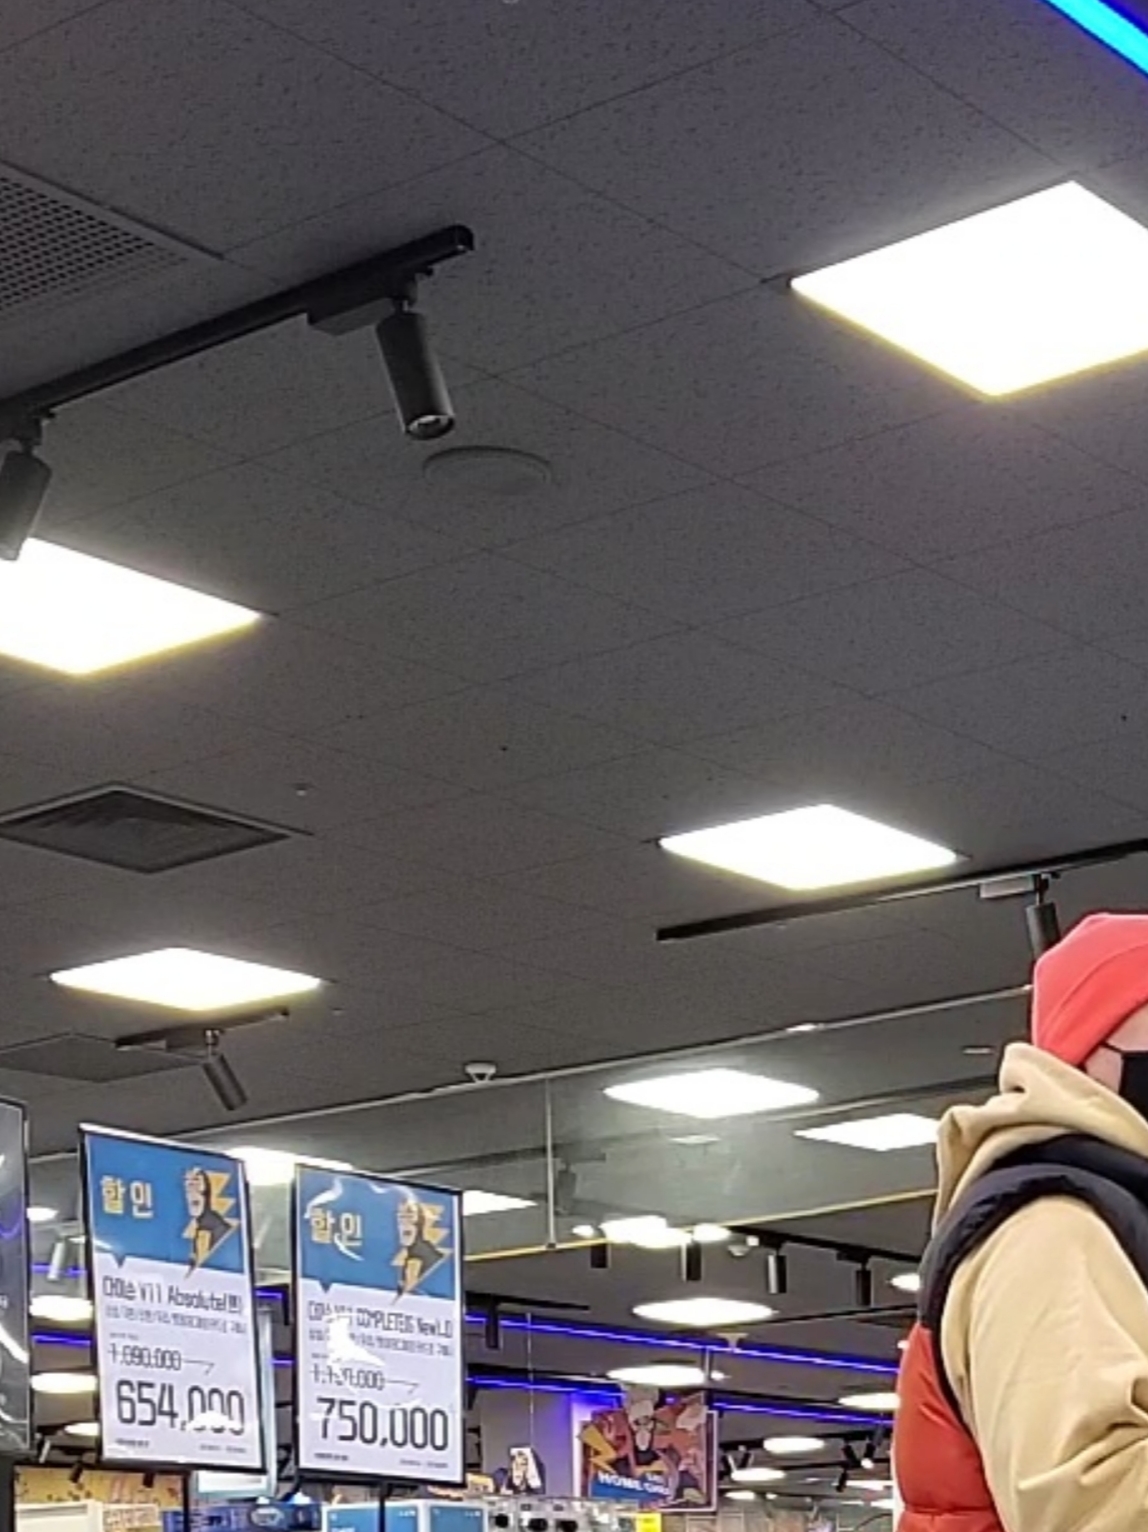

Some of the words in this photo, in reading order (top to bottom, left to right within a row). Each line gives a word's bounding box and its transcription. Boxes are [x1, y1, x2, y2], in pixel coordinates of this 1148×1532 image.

[99, 1174, 154, 1219] 할인
[309, 1206, 363, 1247] 할인
[116, 1379, 245, 1436] 654,000
[316, 1396, 449, 1451] 750,000
